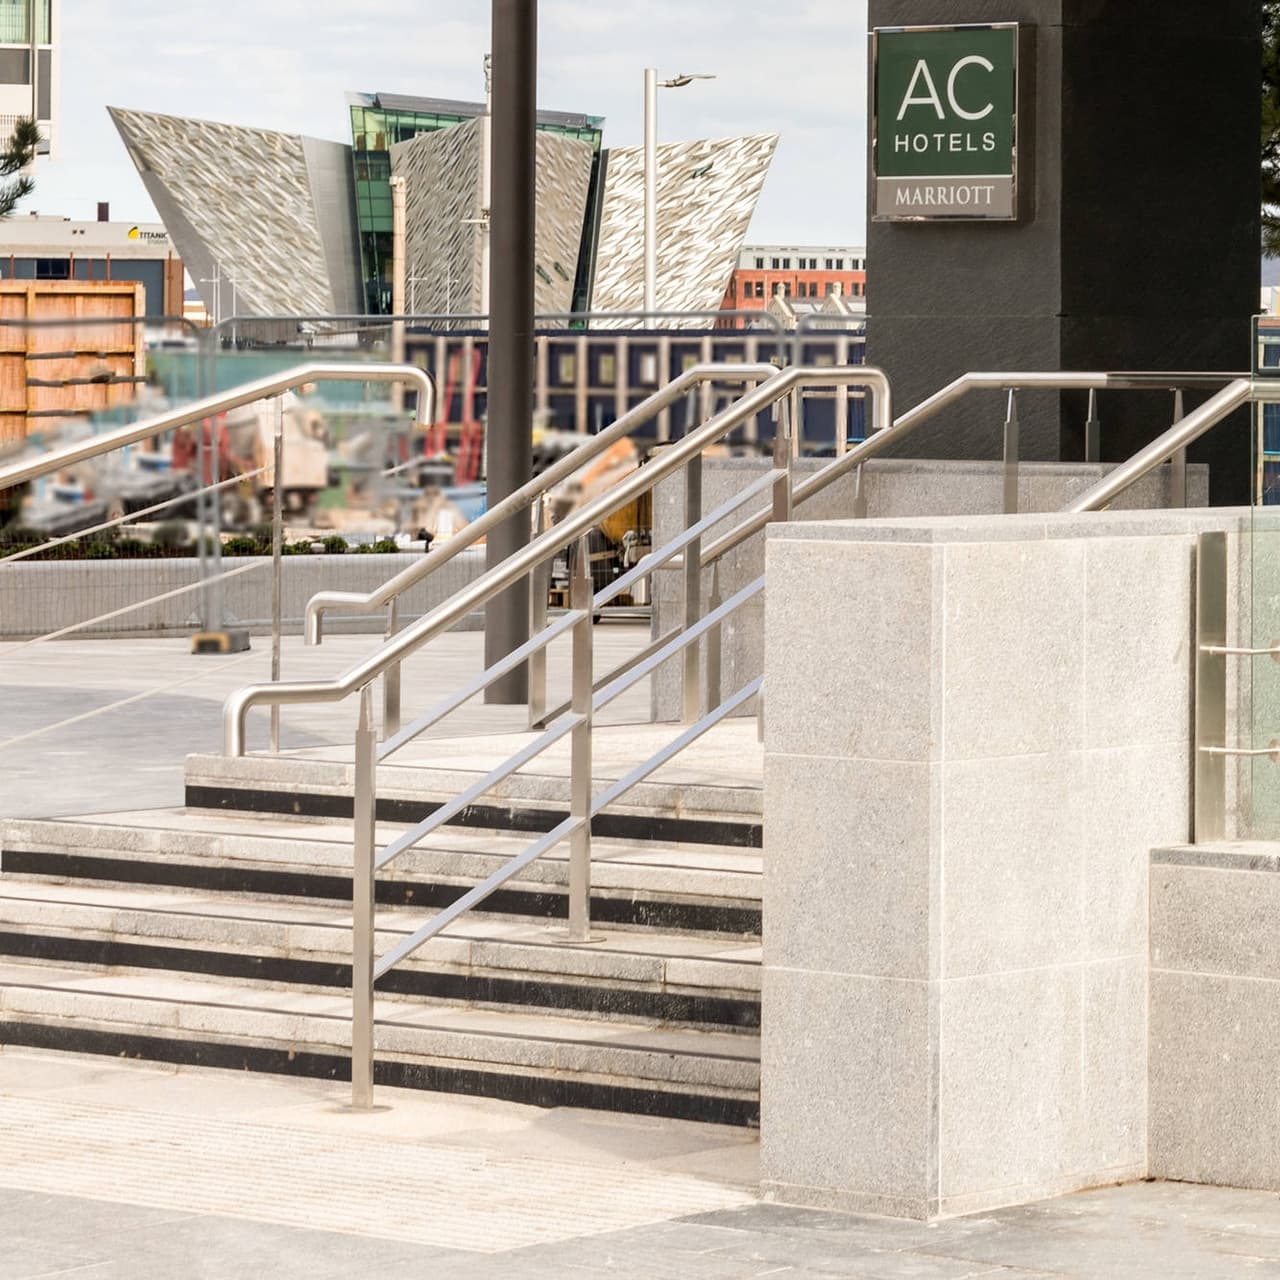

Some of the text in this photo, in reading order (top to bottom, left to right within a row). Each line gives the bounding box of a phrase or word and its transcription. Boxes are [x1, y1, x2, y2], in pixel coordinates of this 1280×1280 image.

[896, 55, 994, 120] AC
[895, 132, 995, 152] HOTELS
[895, 185, 995, 205] MARRIOTT
